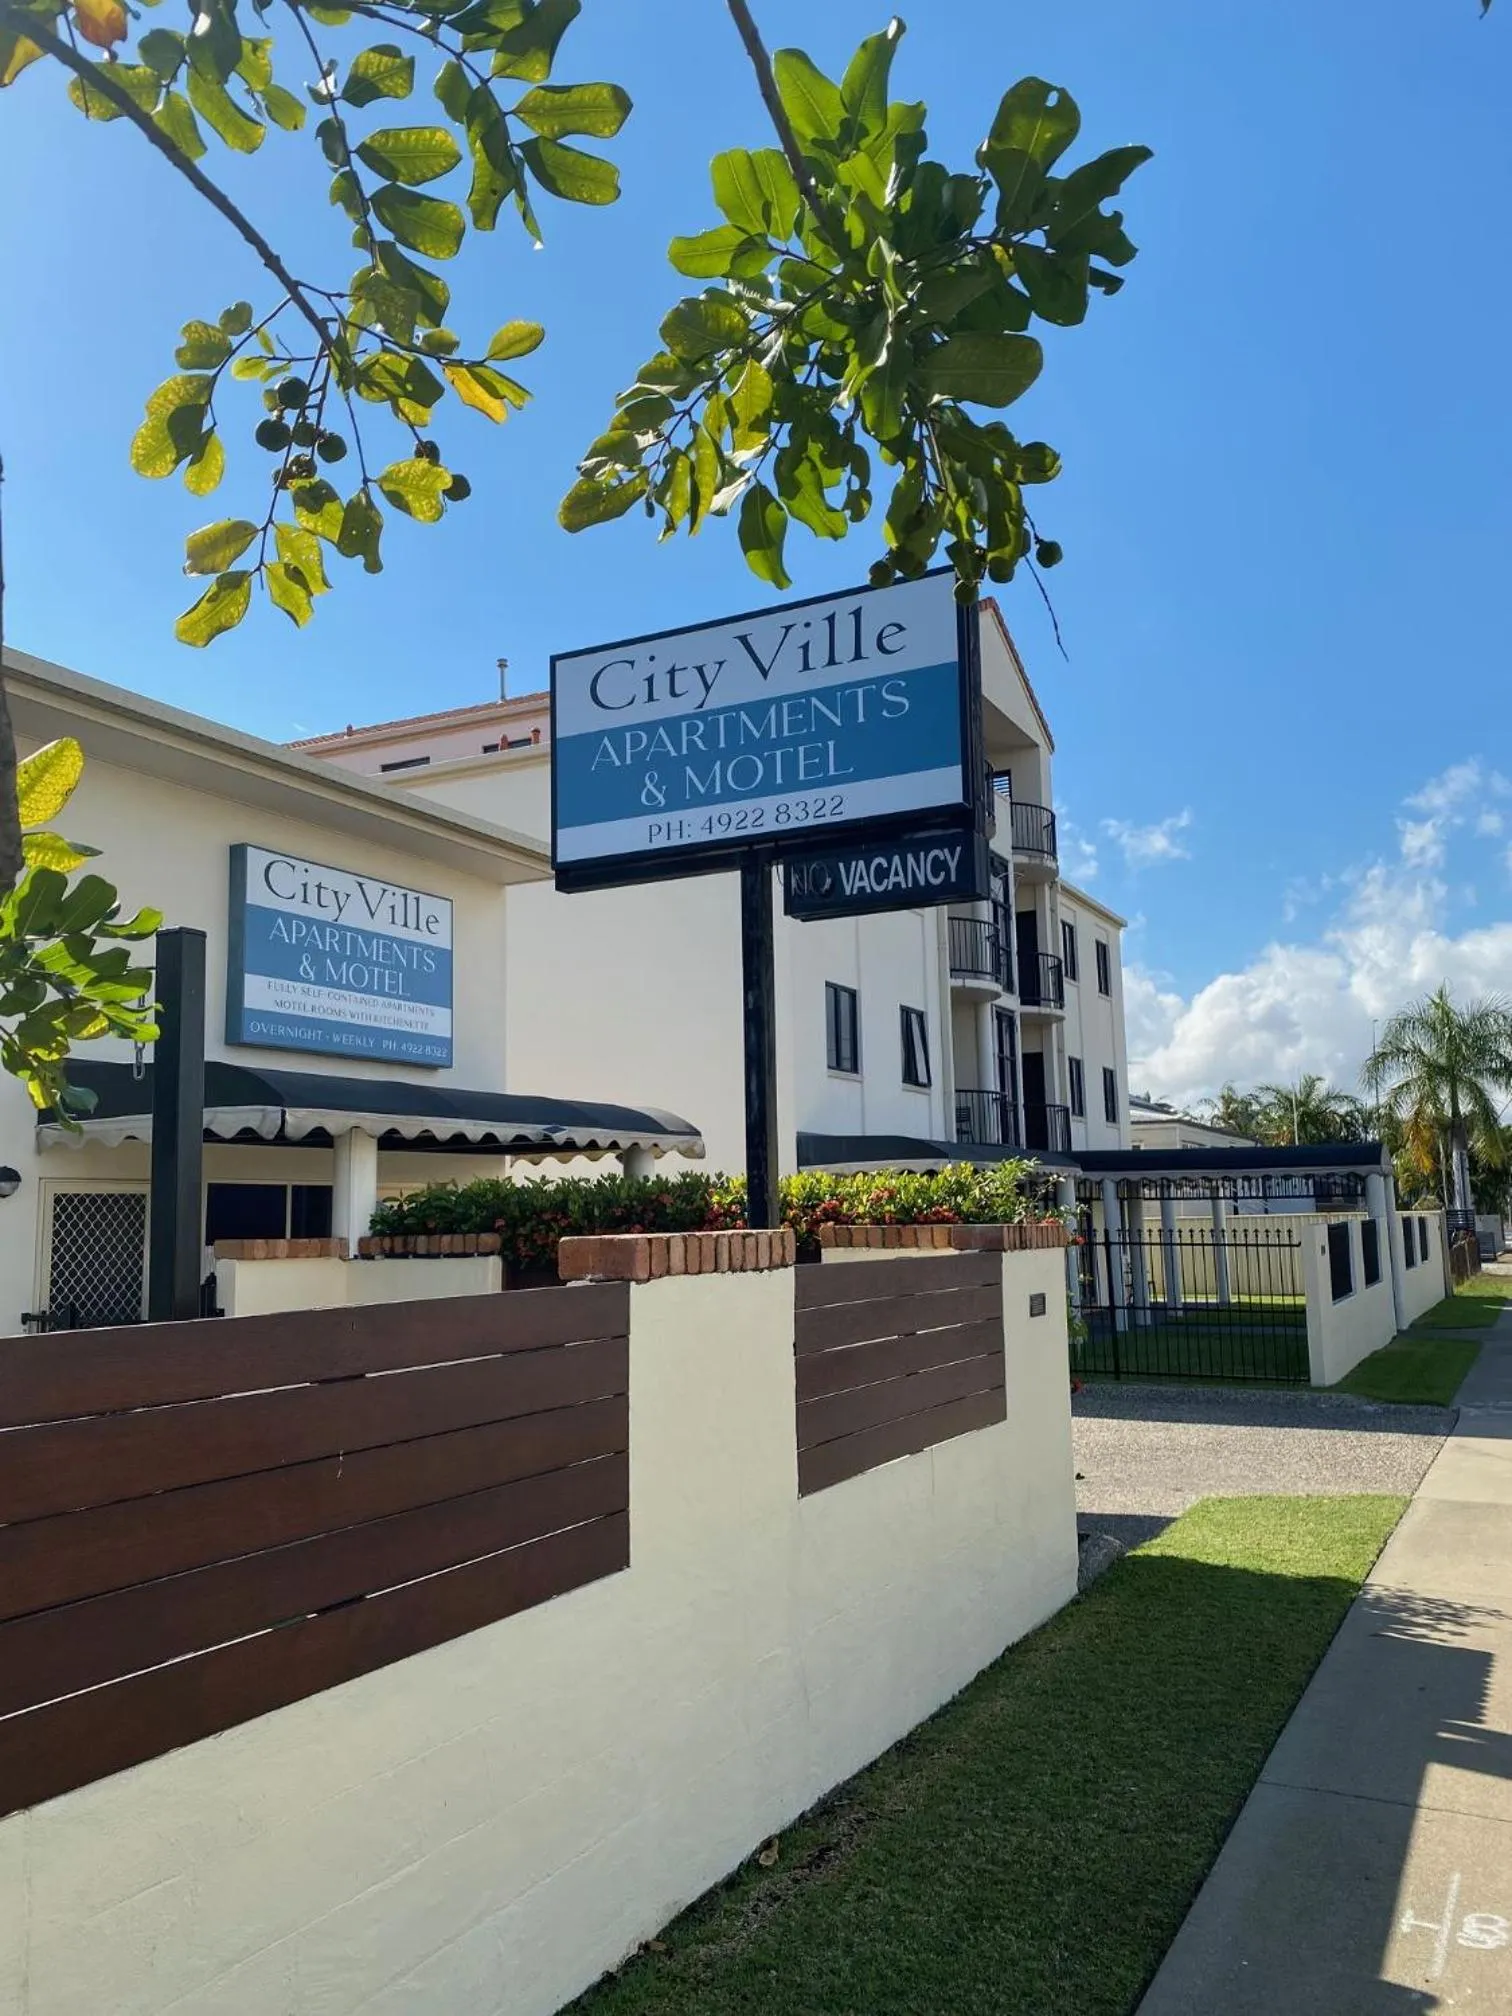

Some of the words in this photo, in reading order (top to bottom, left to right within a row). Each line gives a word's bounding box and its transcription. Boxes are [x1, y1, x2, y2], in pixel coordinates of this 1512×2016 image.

[589, 654, 728, 711] City
[733, 605, 907, 681] Ville
[591, 680, 910, 771] APARTMENTS
[640, 769, 668, 808] &
[685, 740, 854, 800] MOTEL
[648, 820, 692, 843] PH:
[700, 808, 765, 834] 4922
[774, 795, 845, 825] 8322
[264, 859, 351, 922] City
[355, 880, 440, 935] Ville
[838, 846, 962, 897] VACANCY
[269, 917, 436, 973] APARTMENTS
[267, 980, 299, 994] FULLY
[380, 1000, 435, 1017] APARTMENTS
[299, 952, 316, 982] &
[326, 958, 411, 997] MOTEL
[274, 1000, 308, 1013] MOTEL
[250, 1021, 323, 1041] OVERNIGHT
[332, 1032, 376, 1048] WEEKLY
[400, 1041, 423, 1055] 4922
[424, 1045, 448, 1057] 8322
